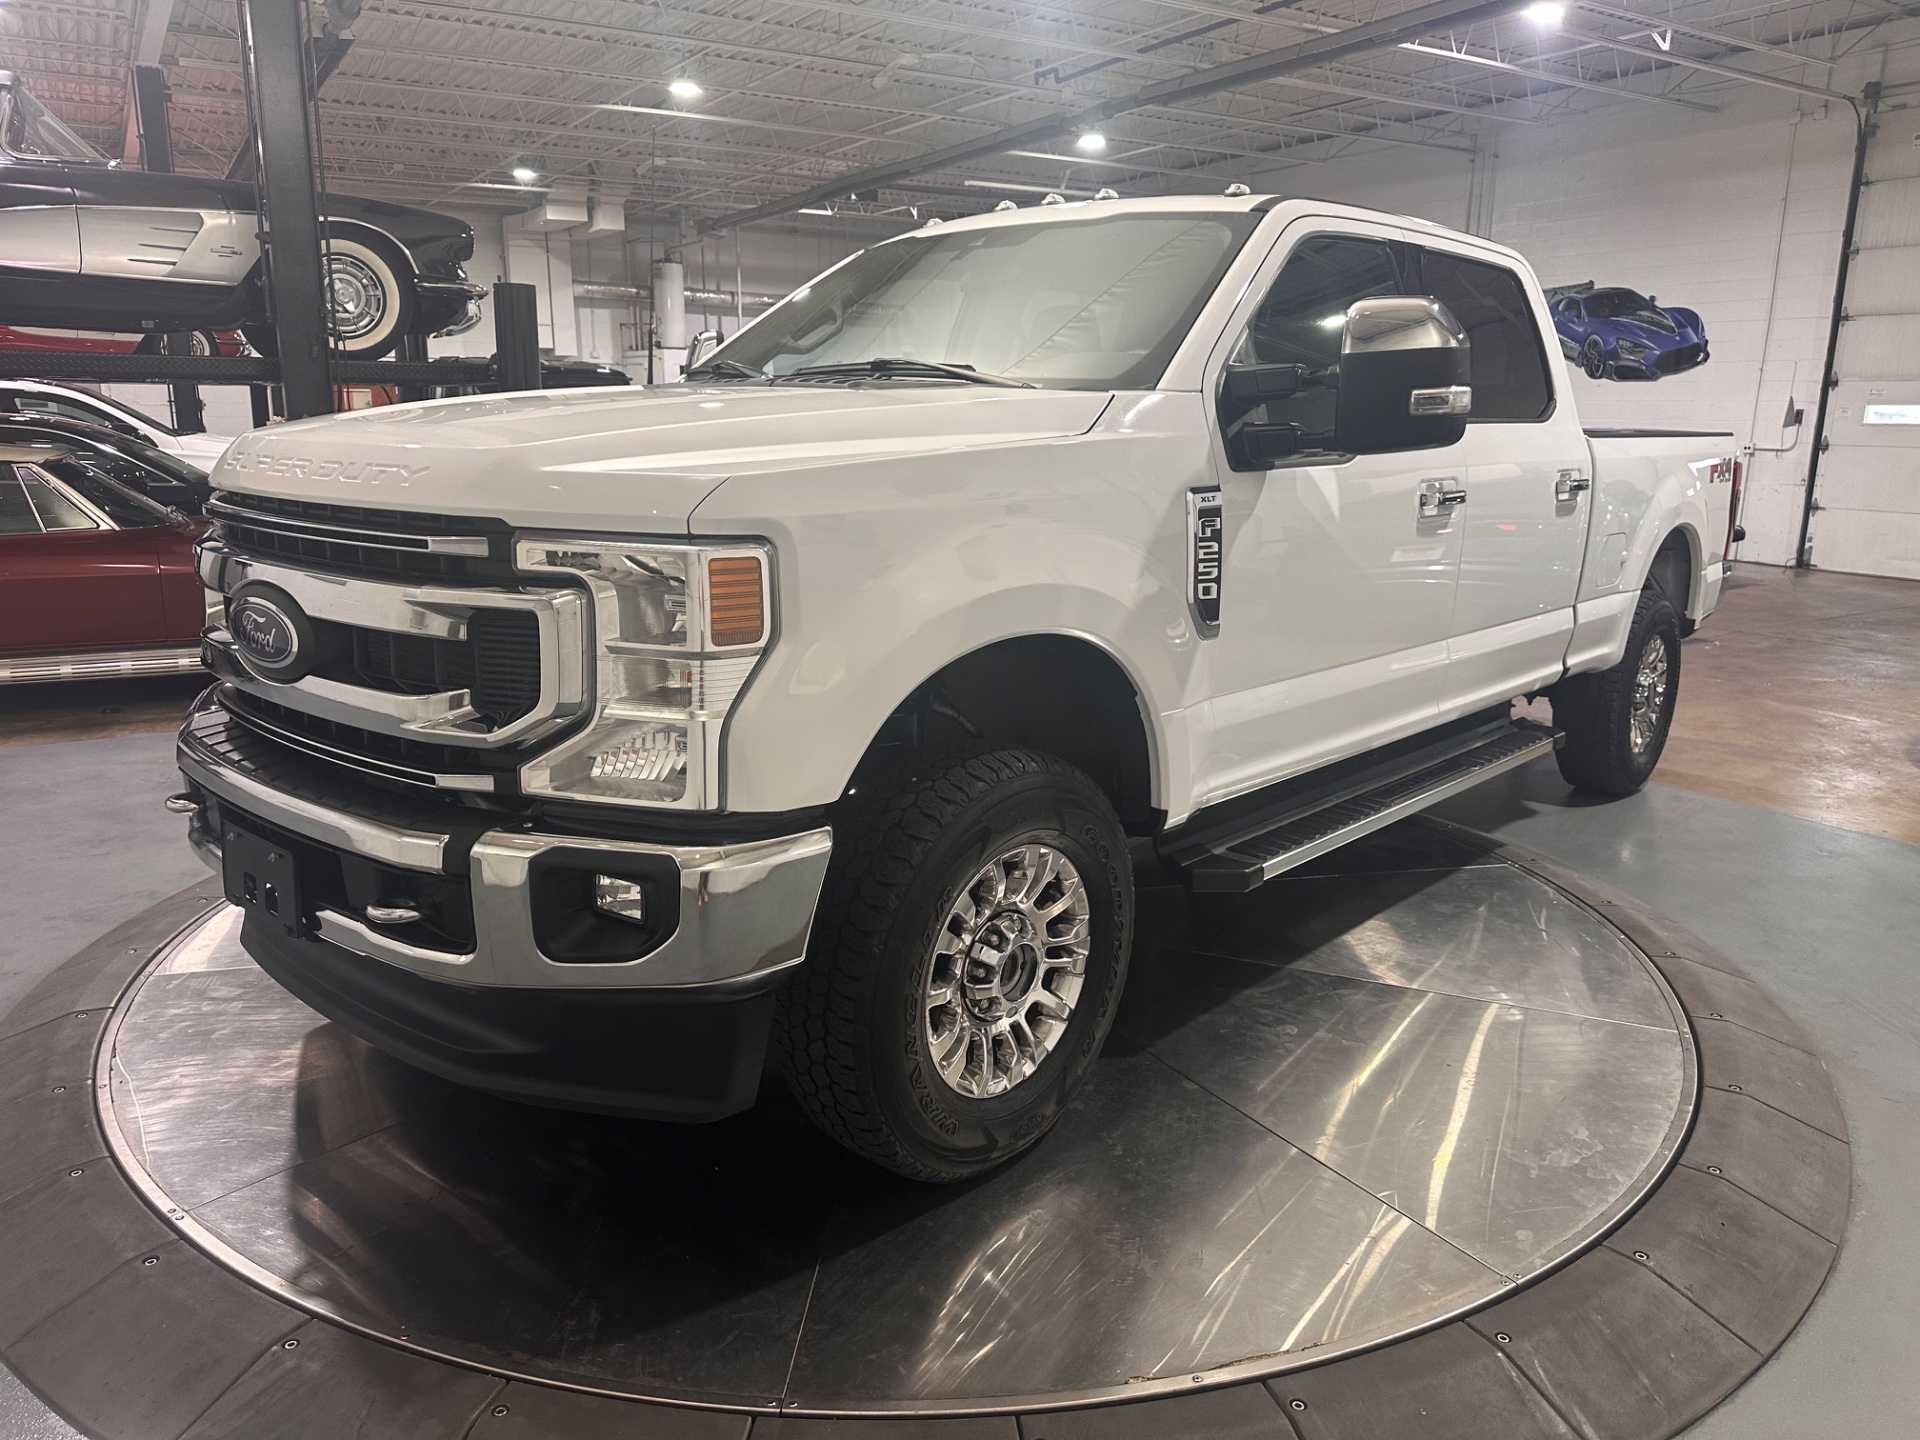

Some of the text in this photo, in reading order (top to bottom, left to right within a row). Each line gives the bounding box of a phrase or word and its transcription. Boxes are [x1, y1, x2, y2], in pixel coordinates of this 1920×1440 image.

[224, 451, 431, 486] SUPER DUTY
[1709, 457, 1732, 484] FX4
[1200, 495, 1217, 503] XLT
[1198, 517, 1220, 599] F250
[241, 611, 276, 653] Ford
[906, 885, 960, 1137] WRANGLER
